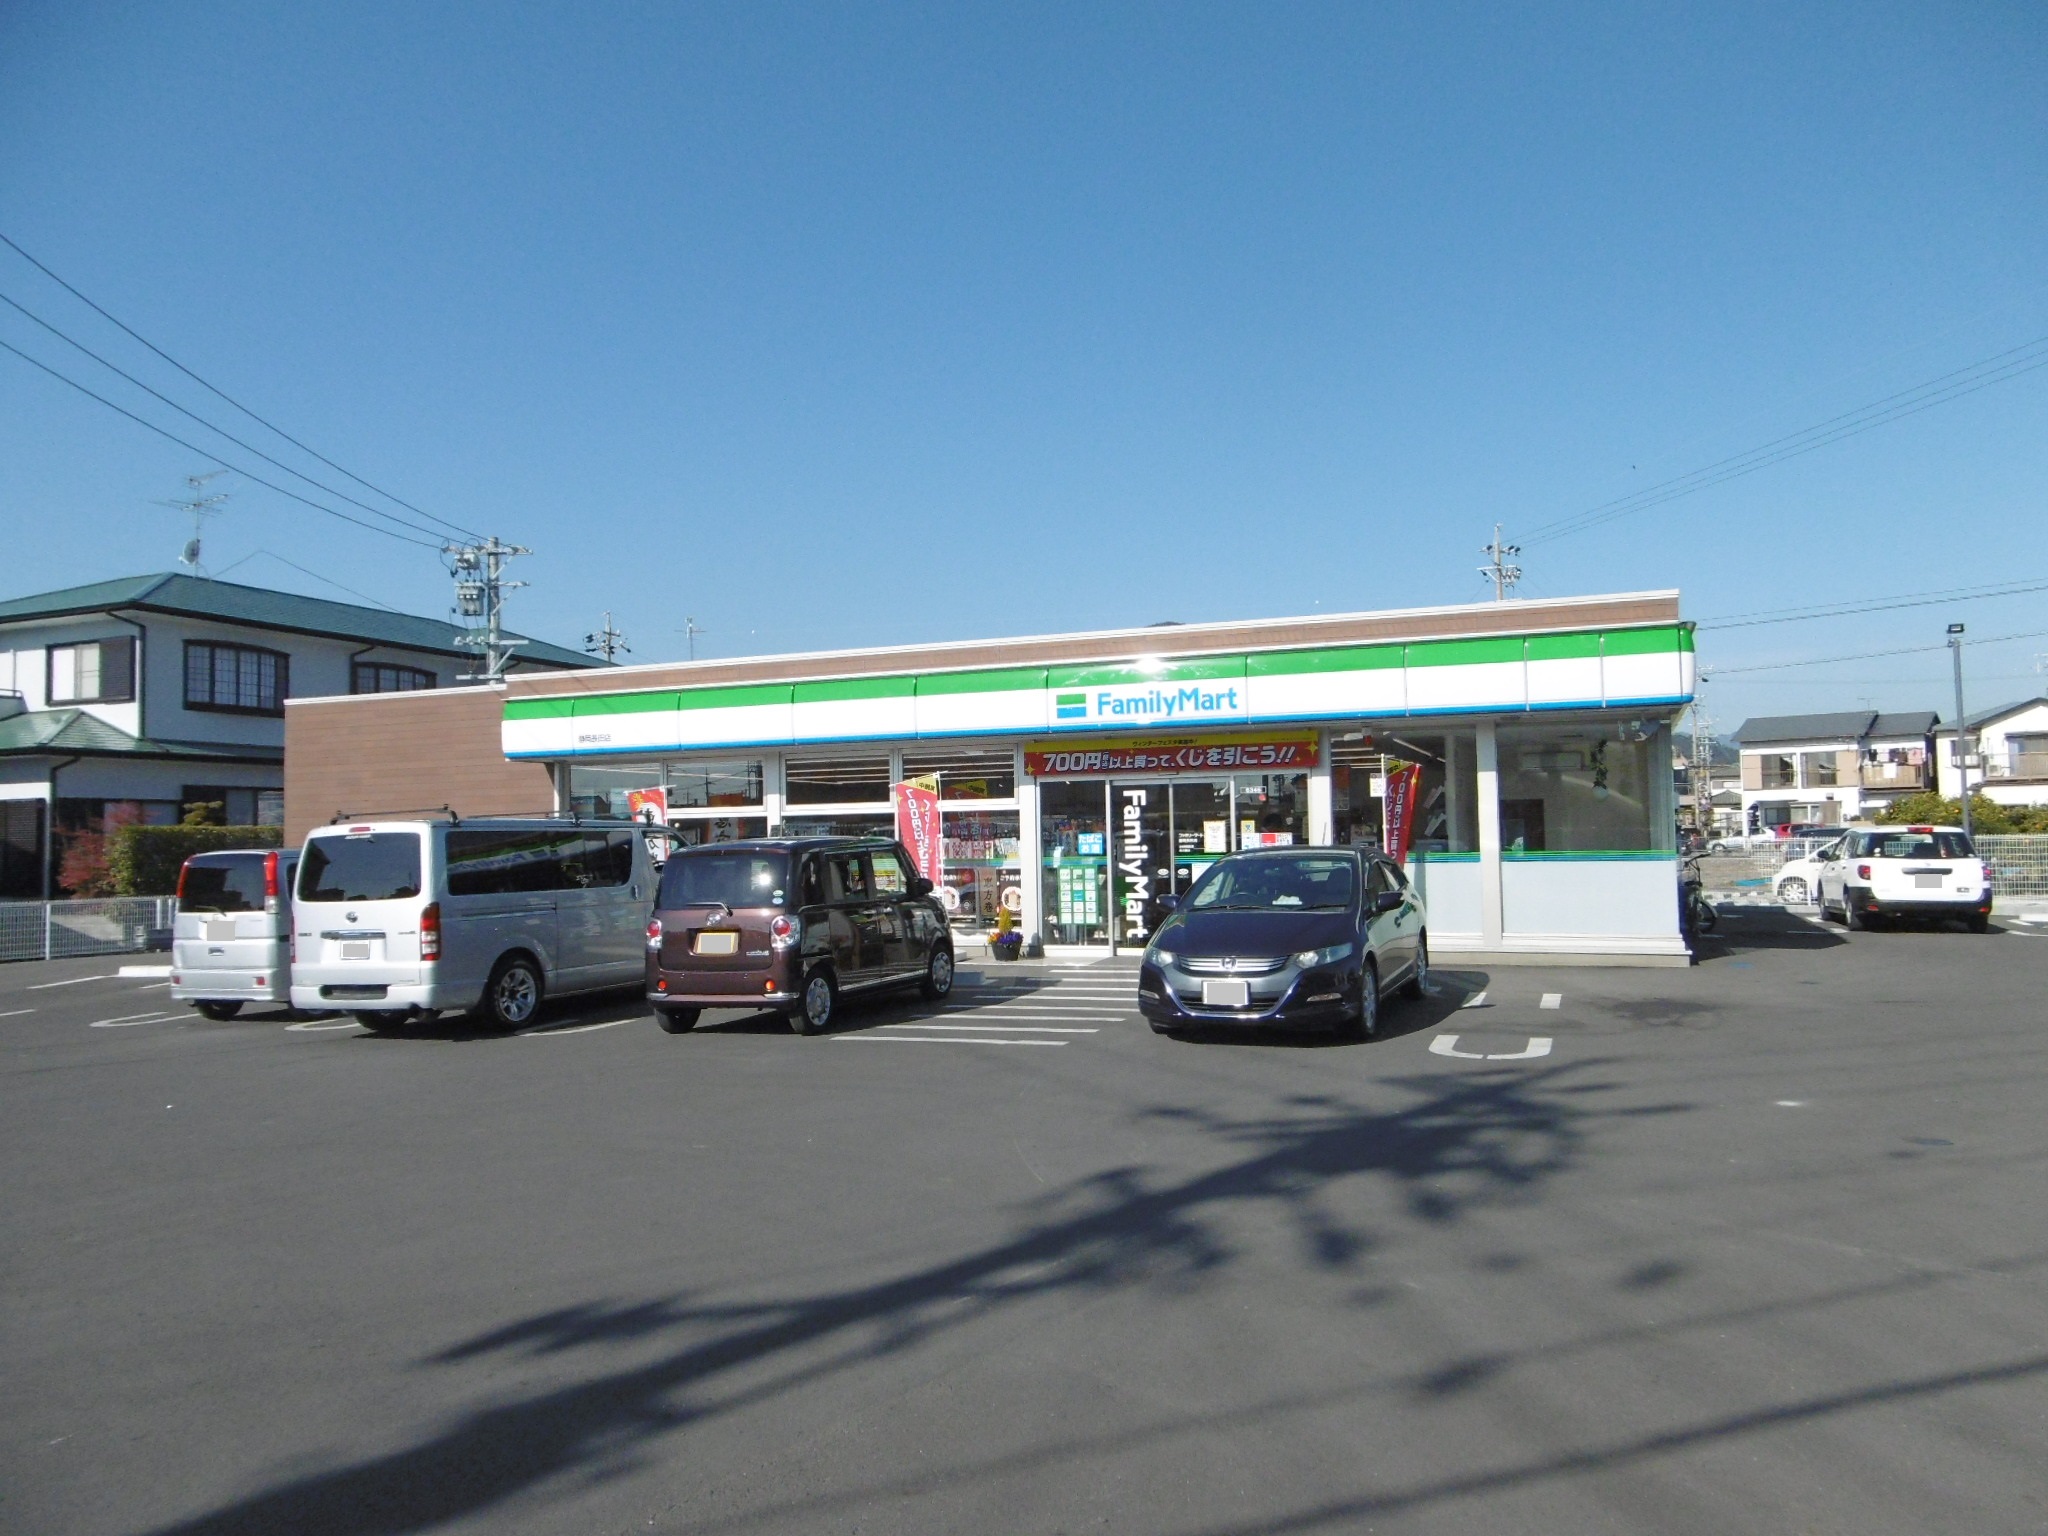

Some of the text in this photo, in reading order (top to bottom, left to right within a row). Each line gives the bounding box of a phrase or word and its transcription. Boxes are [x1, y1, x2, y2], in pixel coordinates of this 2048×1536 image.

[1097, 687, 1238, 716] FamilyMart
[1078, 833, 1102, 844] たばこ
[1119, 789, 1150, 938] FamilyMart
